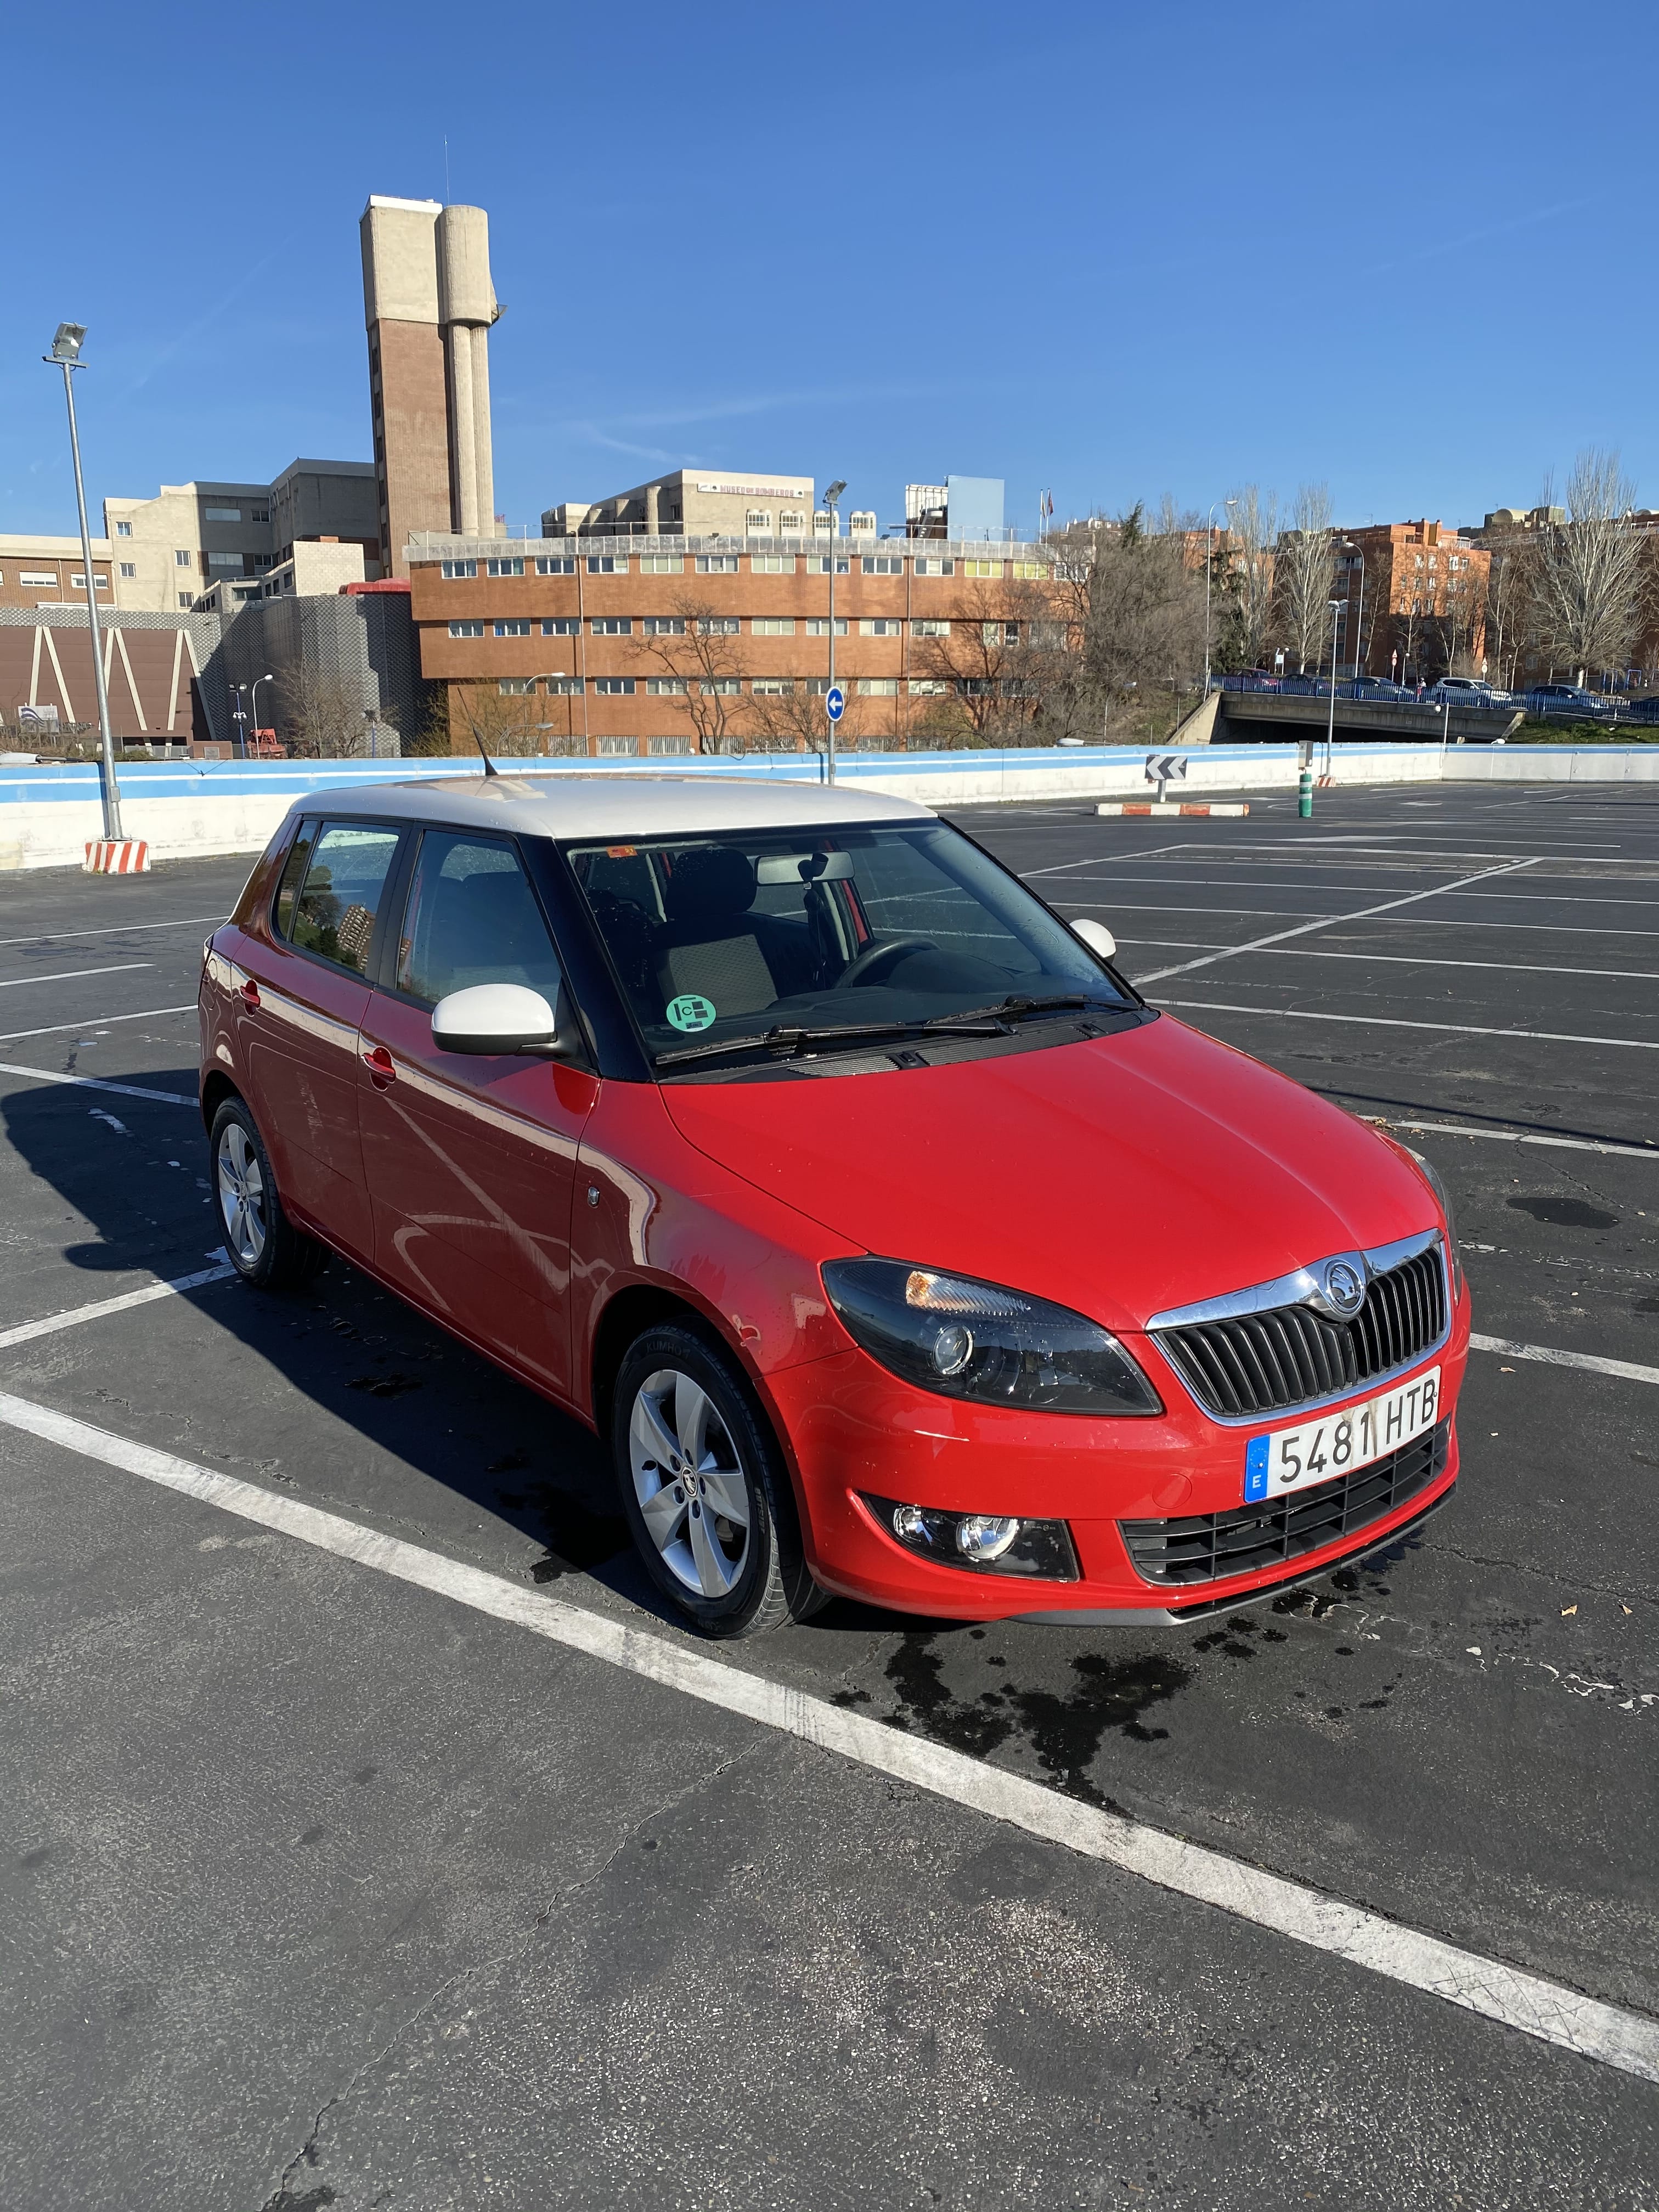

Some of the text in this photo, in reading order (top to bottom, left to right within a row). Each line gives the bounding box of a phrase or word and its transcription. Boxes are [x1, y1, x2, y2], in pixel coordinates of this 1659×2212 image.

[720, 485, 745, 494] MUSEO
[755, 488, 795, 496] BOMBEROS
[681, 1006, 693, 1016] C
[646, 1340, 682, 1355] KUMHO
[1279, 1379, 1436, 1483] 5481 HTB
[1251, 1475, 1262, 1488] E
